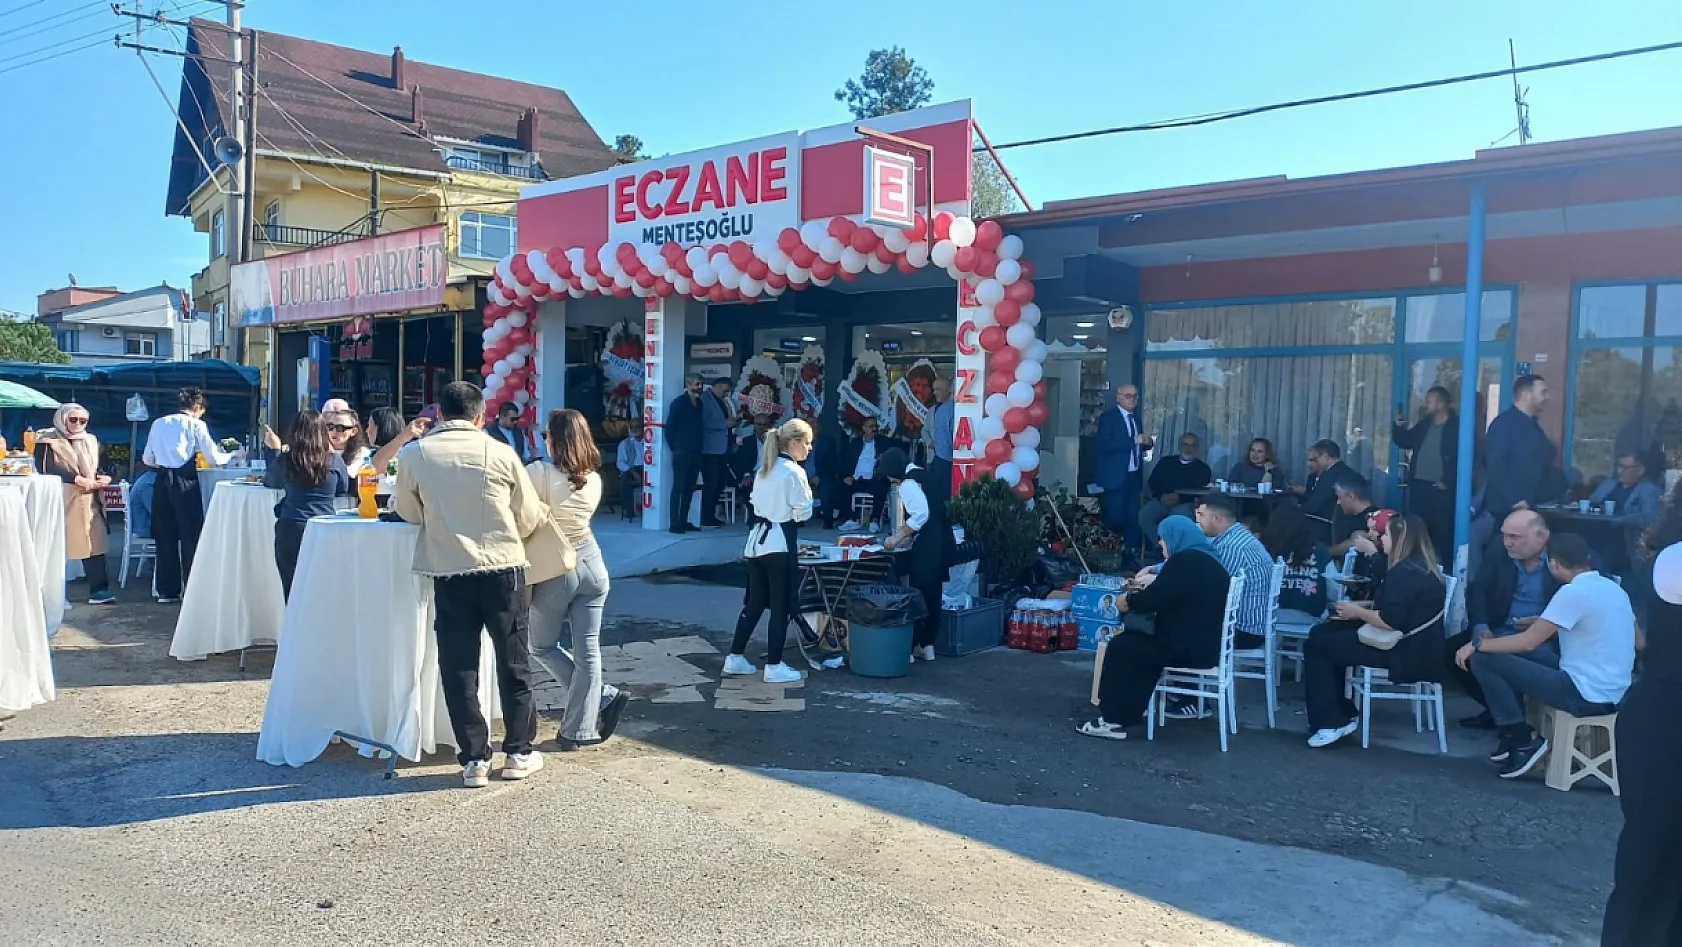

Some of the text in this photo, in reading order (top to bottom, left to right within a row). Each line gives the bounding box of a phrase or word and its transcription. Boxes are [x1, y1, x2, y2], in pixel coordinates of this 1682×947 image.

[615, 146, 787, 223] ECZANE
[880, 166, 904, 212] E
[642, 211, 754, 246] MENTEŞOĞLU
[280, 242, 442, 307] BUHARA MARKET
